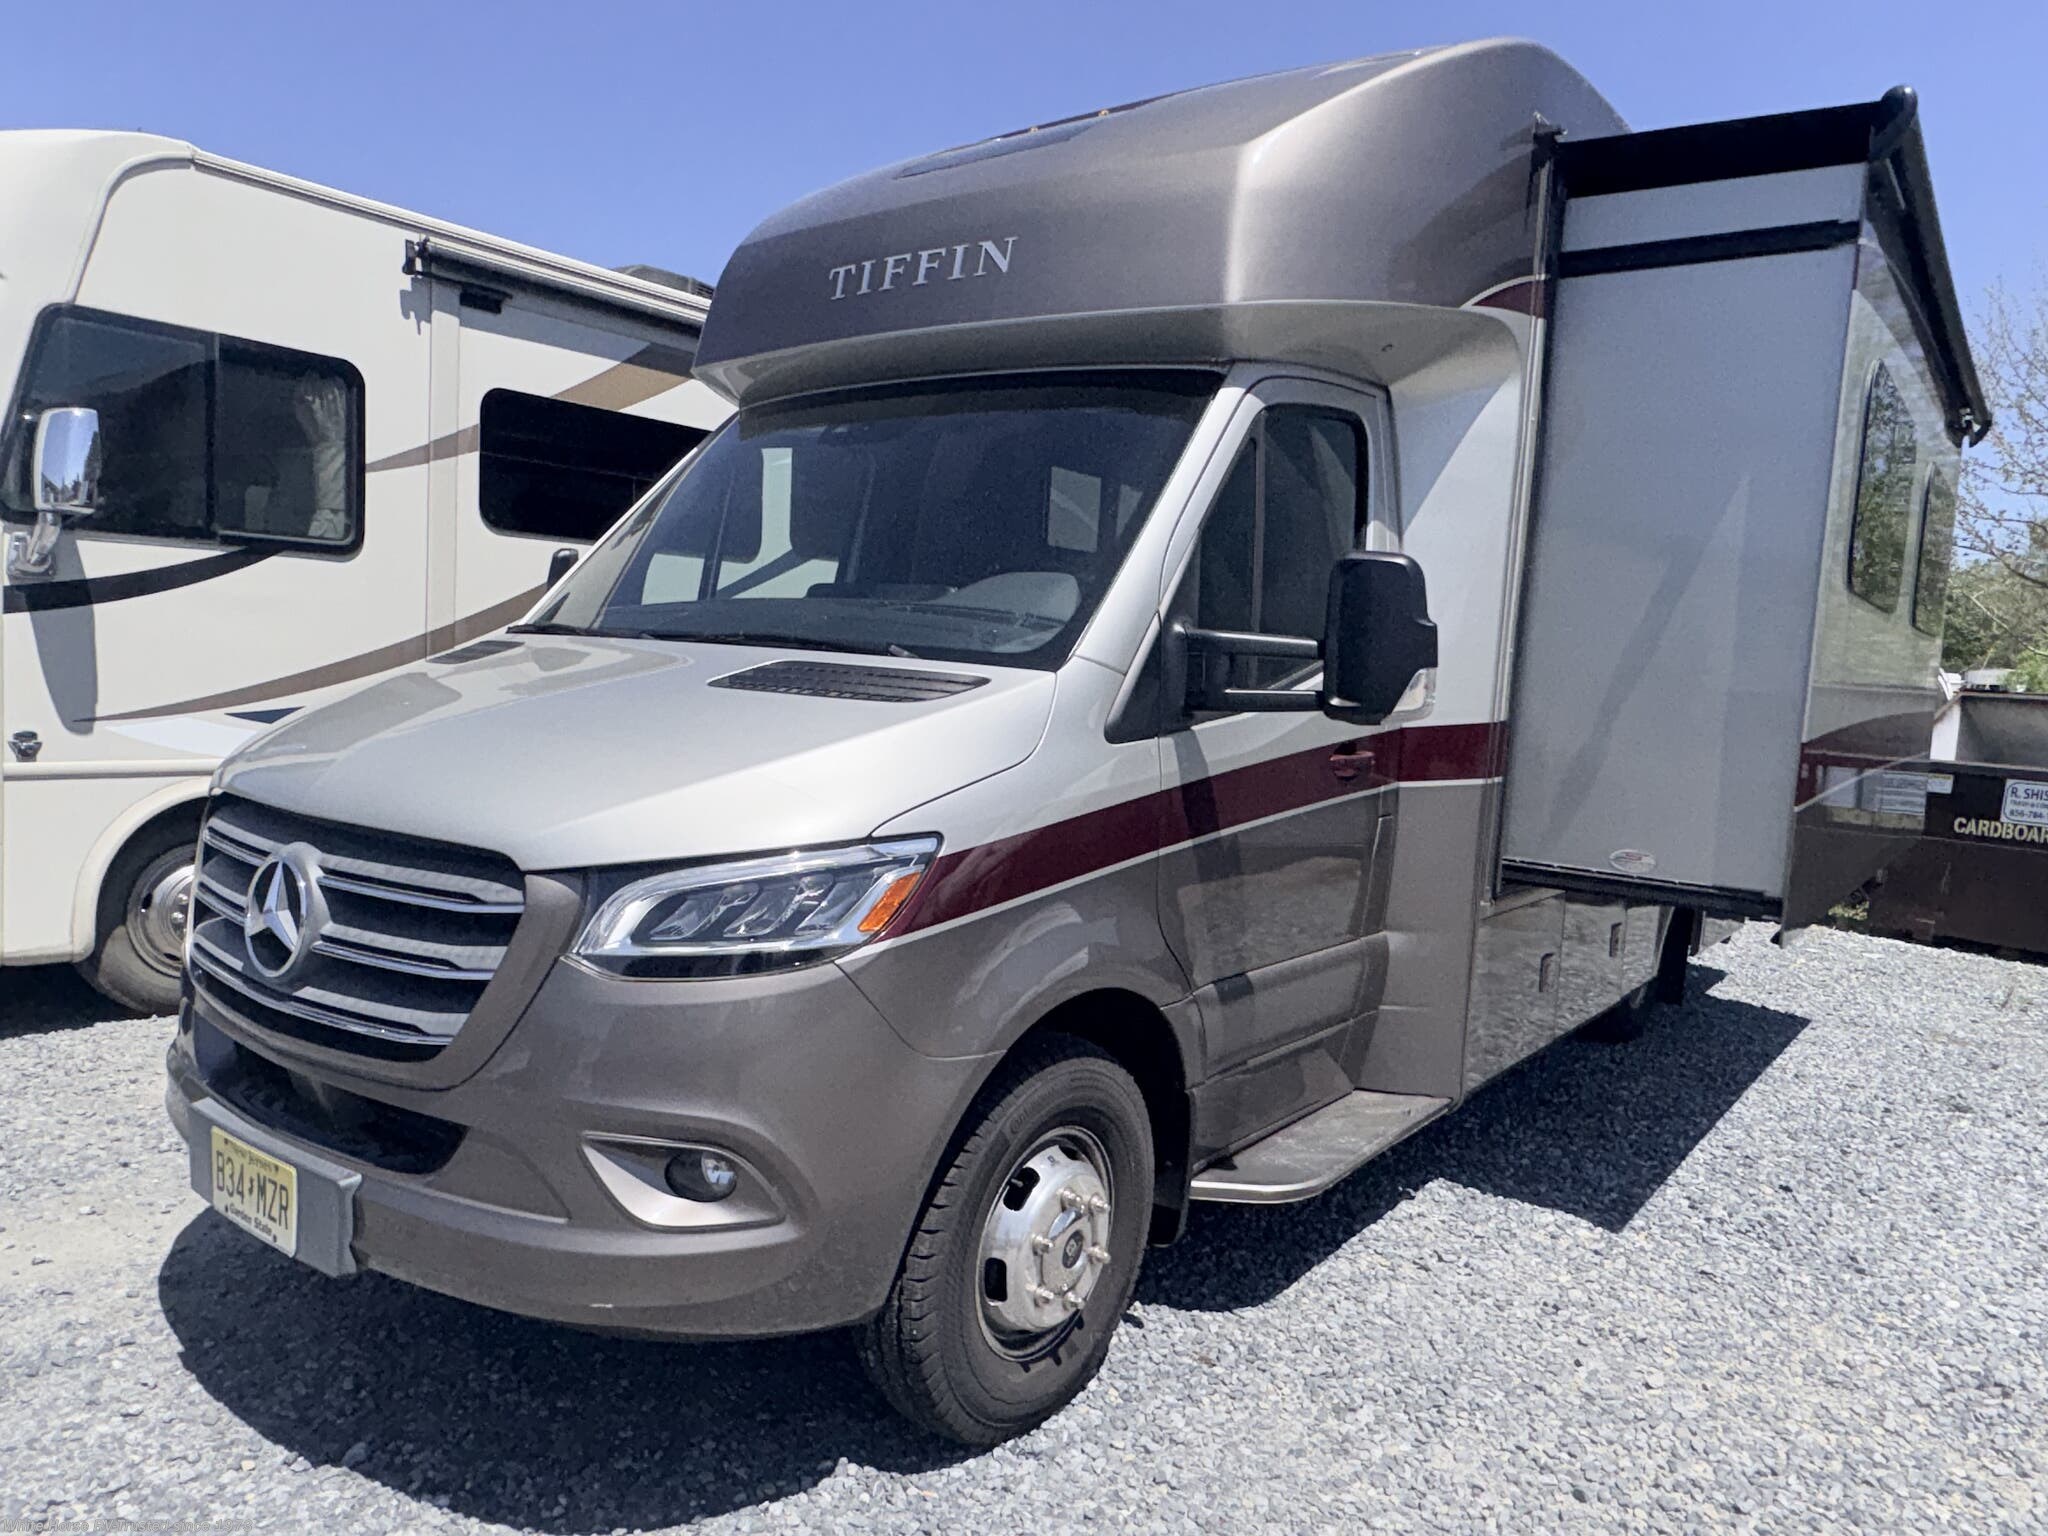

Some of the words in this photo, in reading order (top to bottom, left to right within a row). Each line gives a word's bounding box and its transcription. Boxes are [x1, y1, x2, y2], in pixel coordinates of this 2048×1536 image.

[828, 236, 1018, 300] TIFFIN
[216, 1150, 245, 1205] B34
[256, 1172, 289, 1230] MZR
